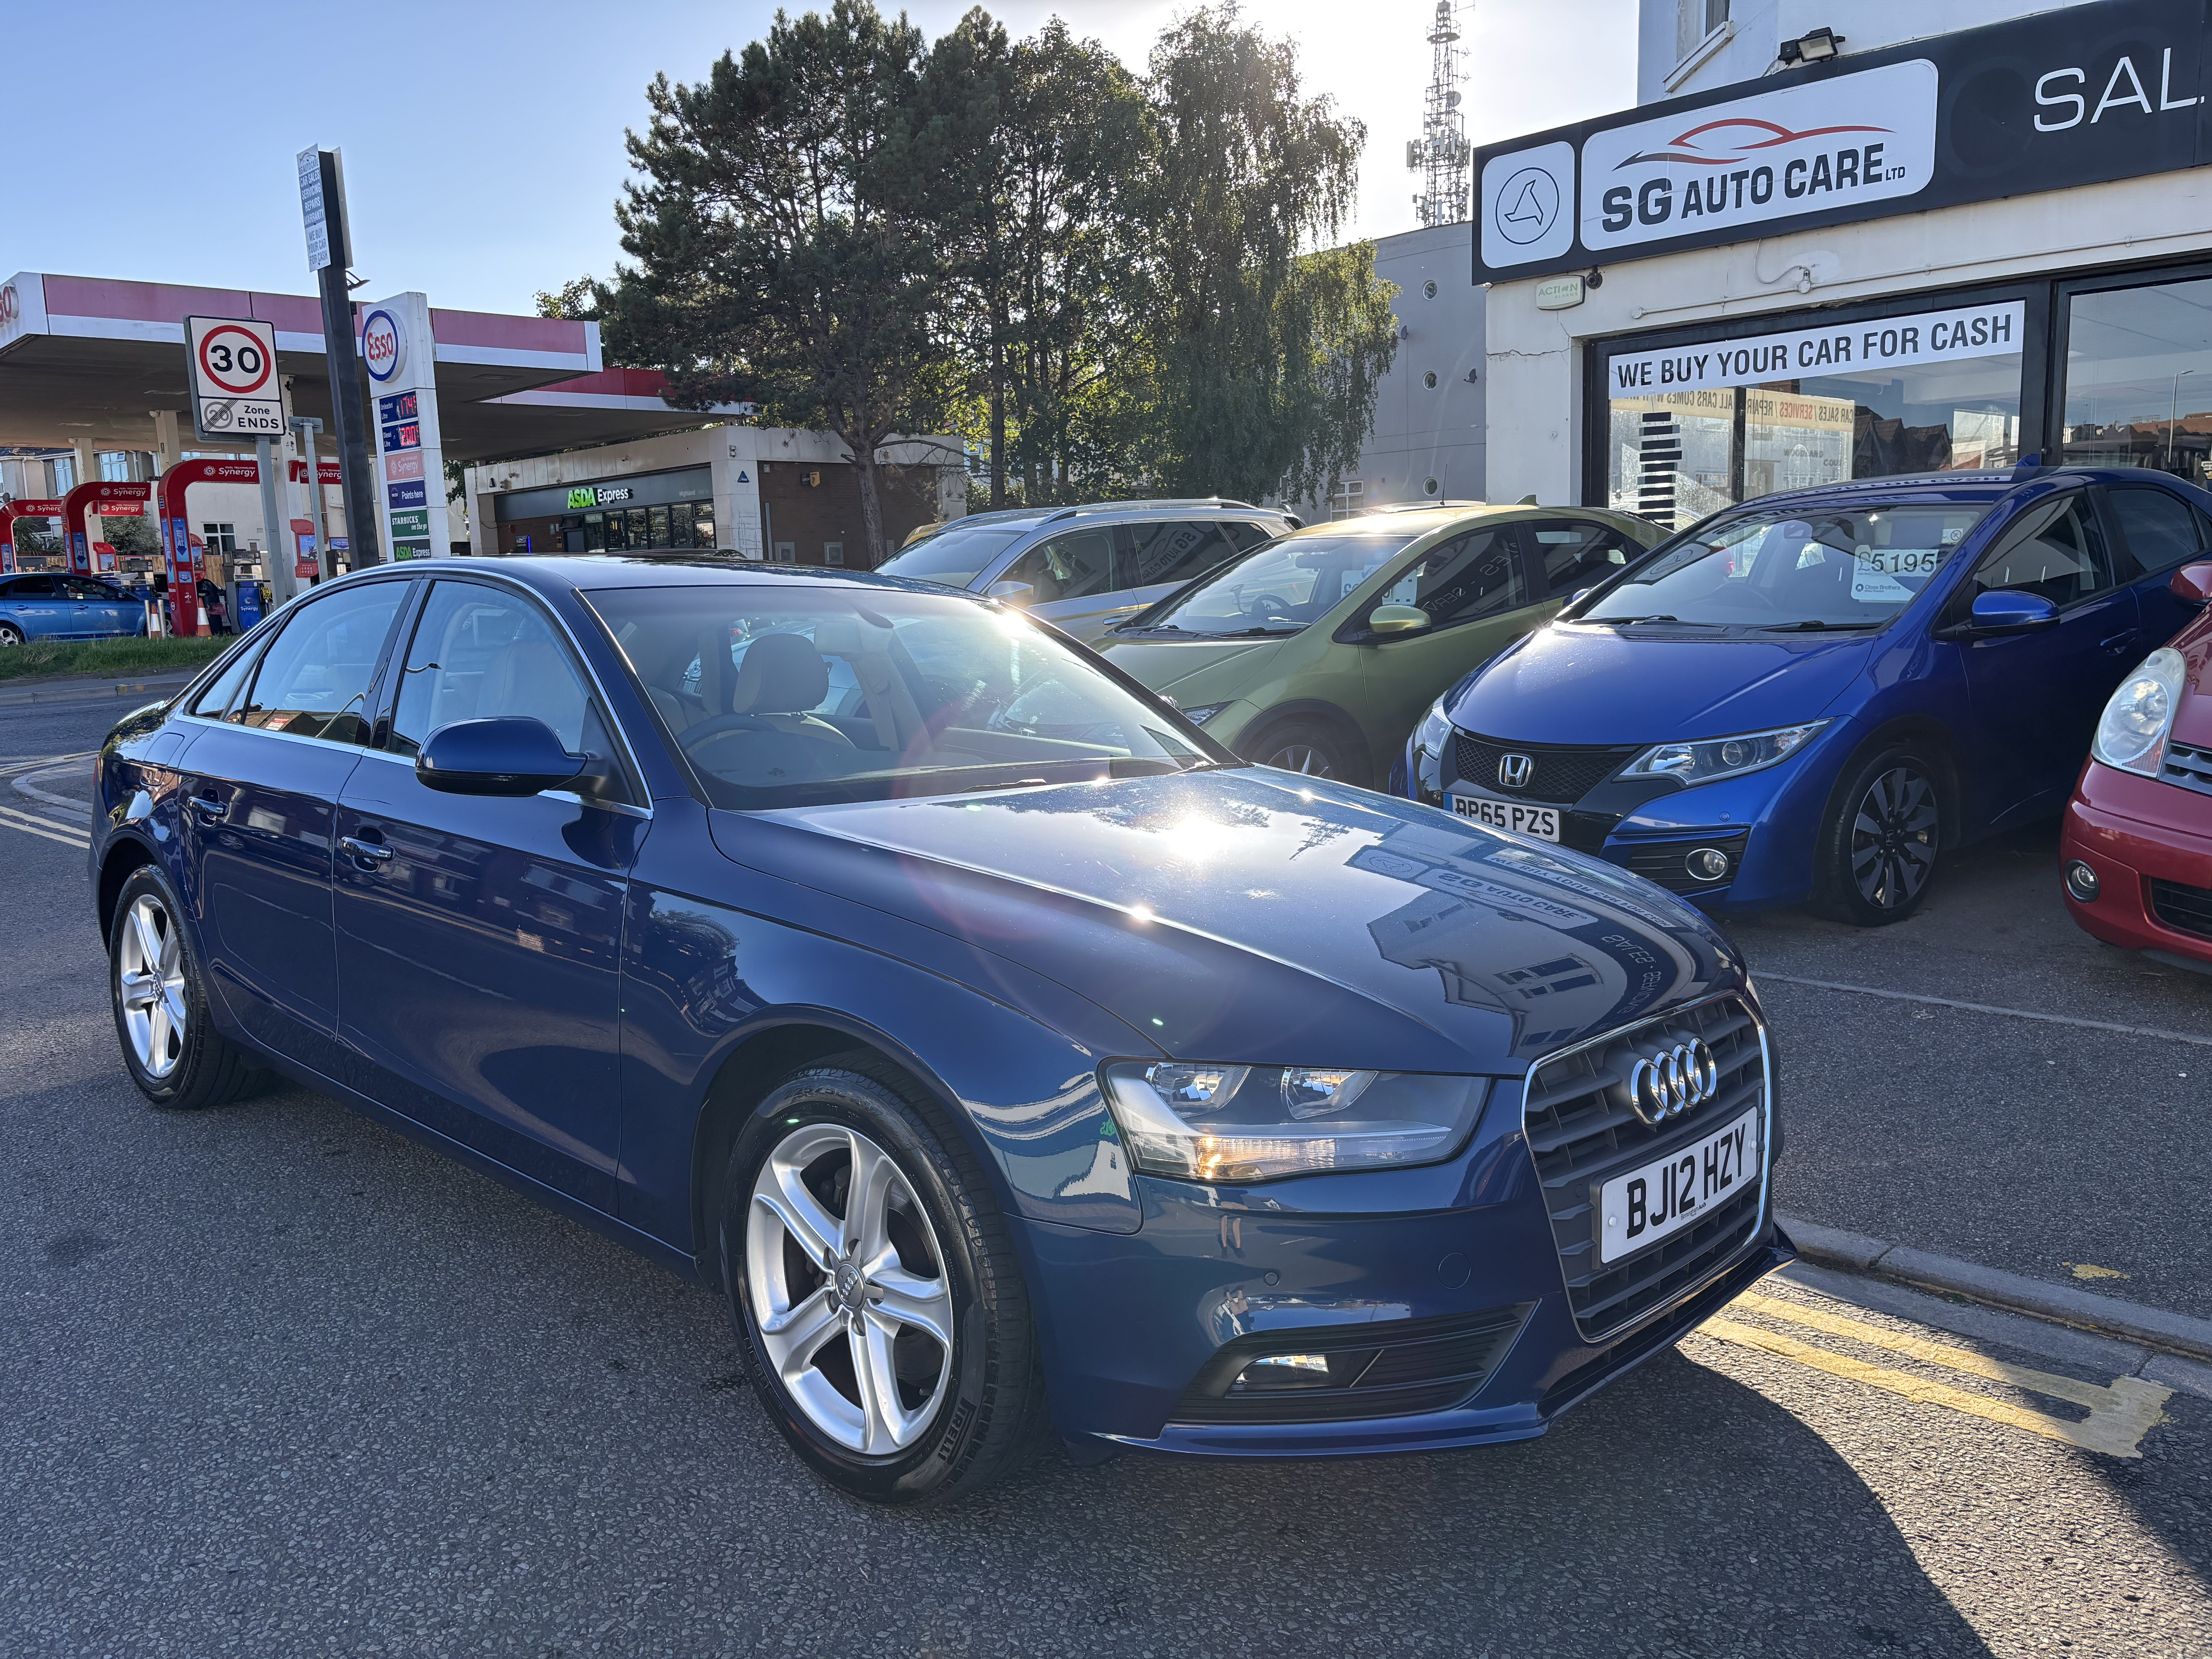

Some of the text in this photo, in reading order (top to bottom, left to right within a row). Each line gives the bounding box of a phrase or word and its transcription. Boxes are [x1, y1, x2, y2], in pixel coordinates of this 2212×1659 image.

[308, 169, 320, 184] SALES
[301, 182, 321, 200] SERVICING
[1602, 143, 1906, 232] SG AUTO CARE LTD
[305, 196, 321, 212] REPAIRS
[304, 208, 324, 226] WARRANTY
[308, 227, 323, 242] WE BUY
[308, 238, 327, 254] YOUR CAR
[309, 251, 328, 265] FOR CASH
[1618, 314, 2011, 388] WE BUY YOUR CAR FOR CASH
[210, 345, 261, 374] 30
[244, 405, 270, 415] Zone
[238, 417, 279, 429] ENDS
[218, 467, 256, 477] Synergy
[317, 470, 342, 479] ynerg
[398, 460, 418, 474] Synergy
[113, 488, 146, 496] Synergy
[402, 491, 414, 499] Points
[414, 490, 423, 498] here
[567, 487, 629, 509] ASDA Express
[392, 515, 419, 525] STARBUCKS
[397, 546, 430, 560] ASDA Express
[1858, 551, 1935, 572] £5195
[1512, 807, 1554, 836] PZS
[1627, 1123, 1745, 1239] BJ12 HZY
